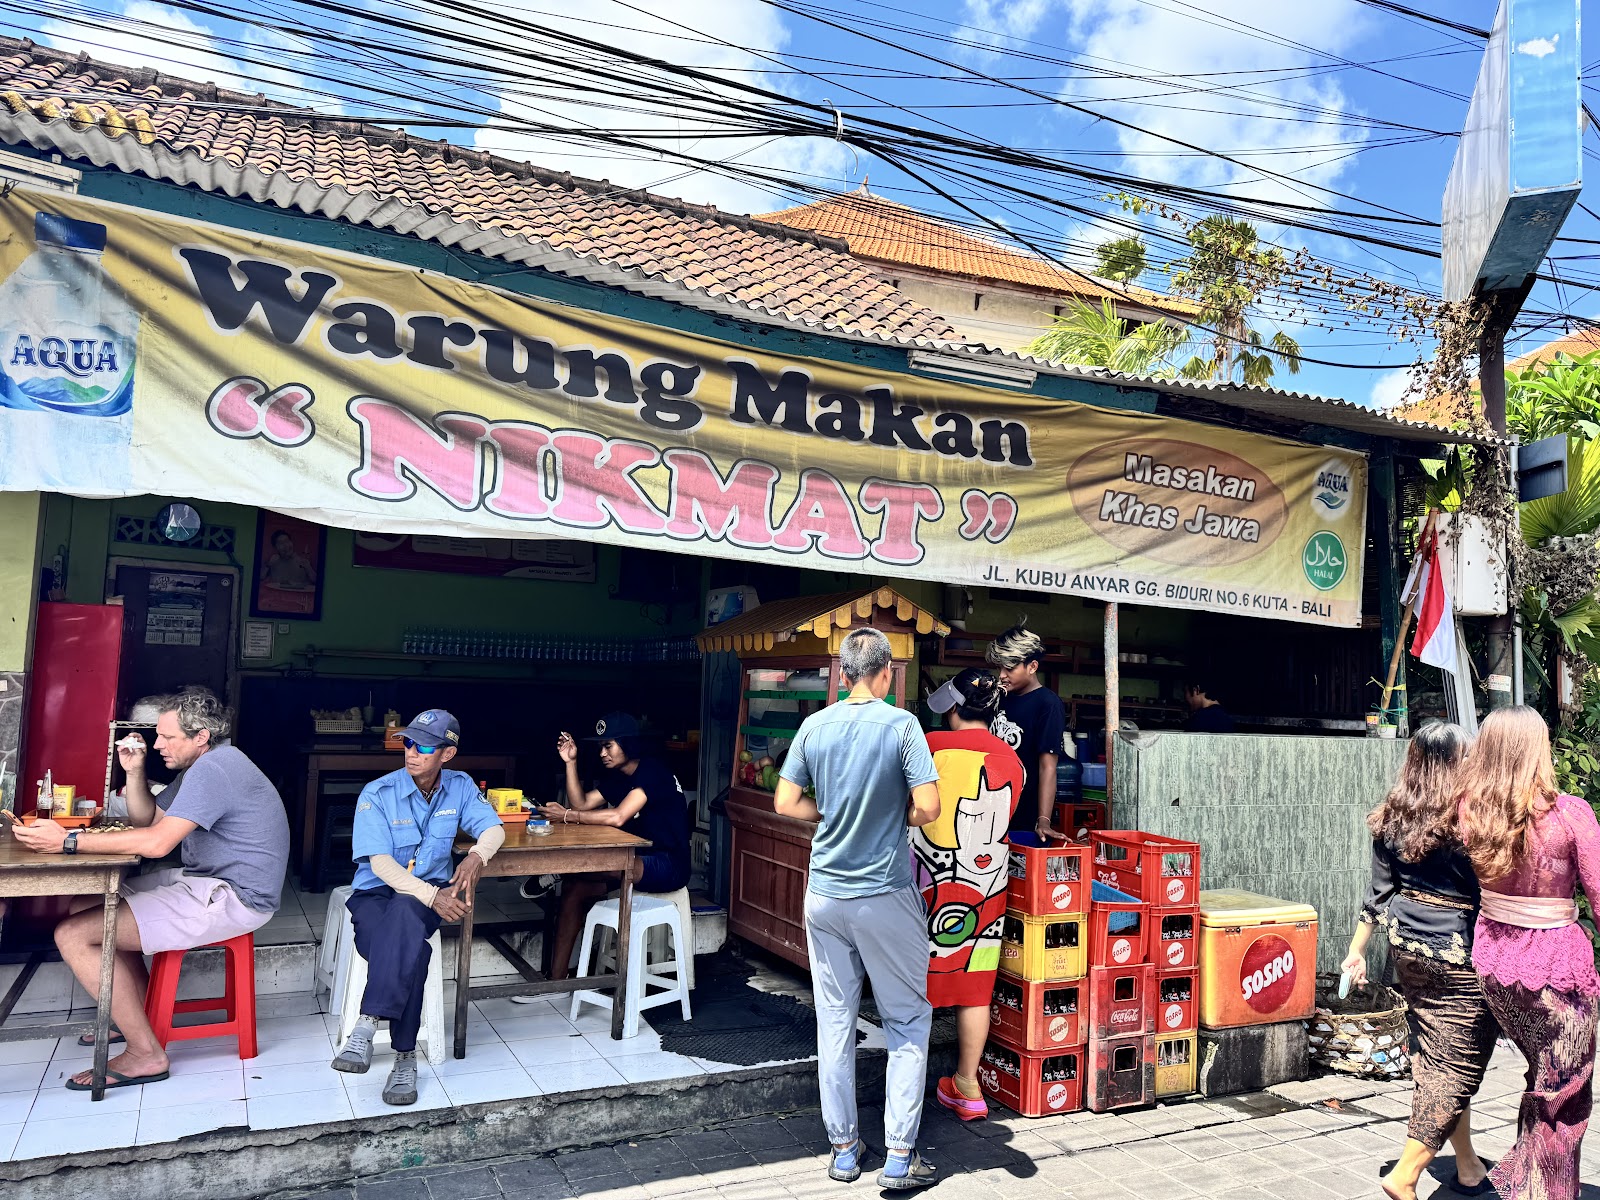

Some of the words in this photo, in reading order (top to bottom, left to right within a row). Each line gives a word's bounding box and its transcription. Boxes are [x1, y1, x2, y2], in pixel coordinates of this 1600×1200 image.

[10, 333, 119, 377] AQUA
[178, 246, 703, 431] Warung
[726, 360, 1034, 467] Makan
[346, 394, 945, 566] NIKMAT
[1124, 452, 1256, 502] Masakan
[1317, 471, 1349, 493] AQUA
[1099, 489, 1179, 531] Khas
[1183, 506, 1261, 543] Jawa
[1306, 539, 1343, 567] حلال
[1313, 568, 1334, 580] HALAL
[982, 565, 1009, 583] JL.
[1015, 568, 1067, 588] KUBU
[1070, 574, 1130, 595] ANYAR
[1134, 580, 1161, 598] GG.
[1165, 583, 1213, 603] BIDURI
[1252, 593, 1289, 612] KUTA
[1301, 600, 1332, 618] BALI
[1052, 888, 1072, 905] SOSRO
[1167, 883, 1185, 897] SOSRO
[1112, 944, 1132, 958] SOSRO
[1241, 950, 1294, 1001] SOSRO
[1050, 1020, 1069, 1037] SOSRO
[1165, 1008, 1182, 1024] SOSRO
[1047, 1088, 1067, 1104] SOSRO
